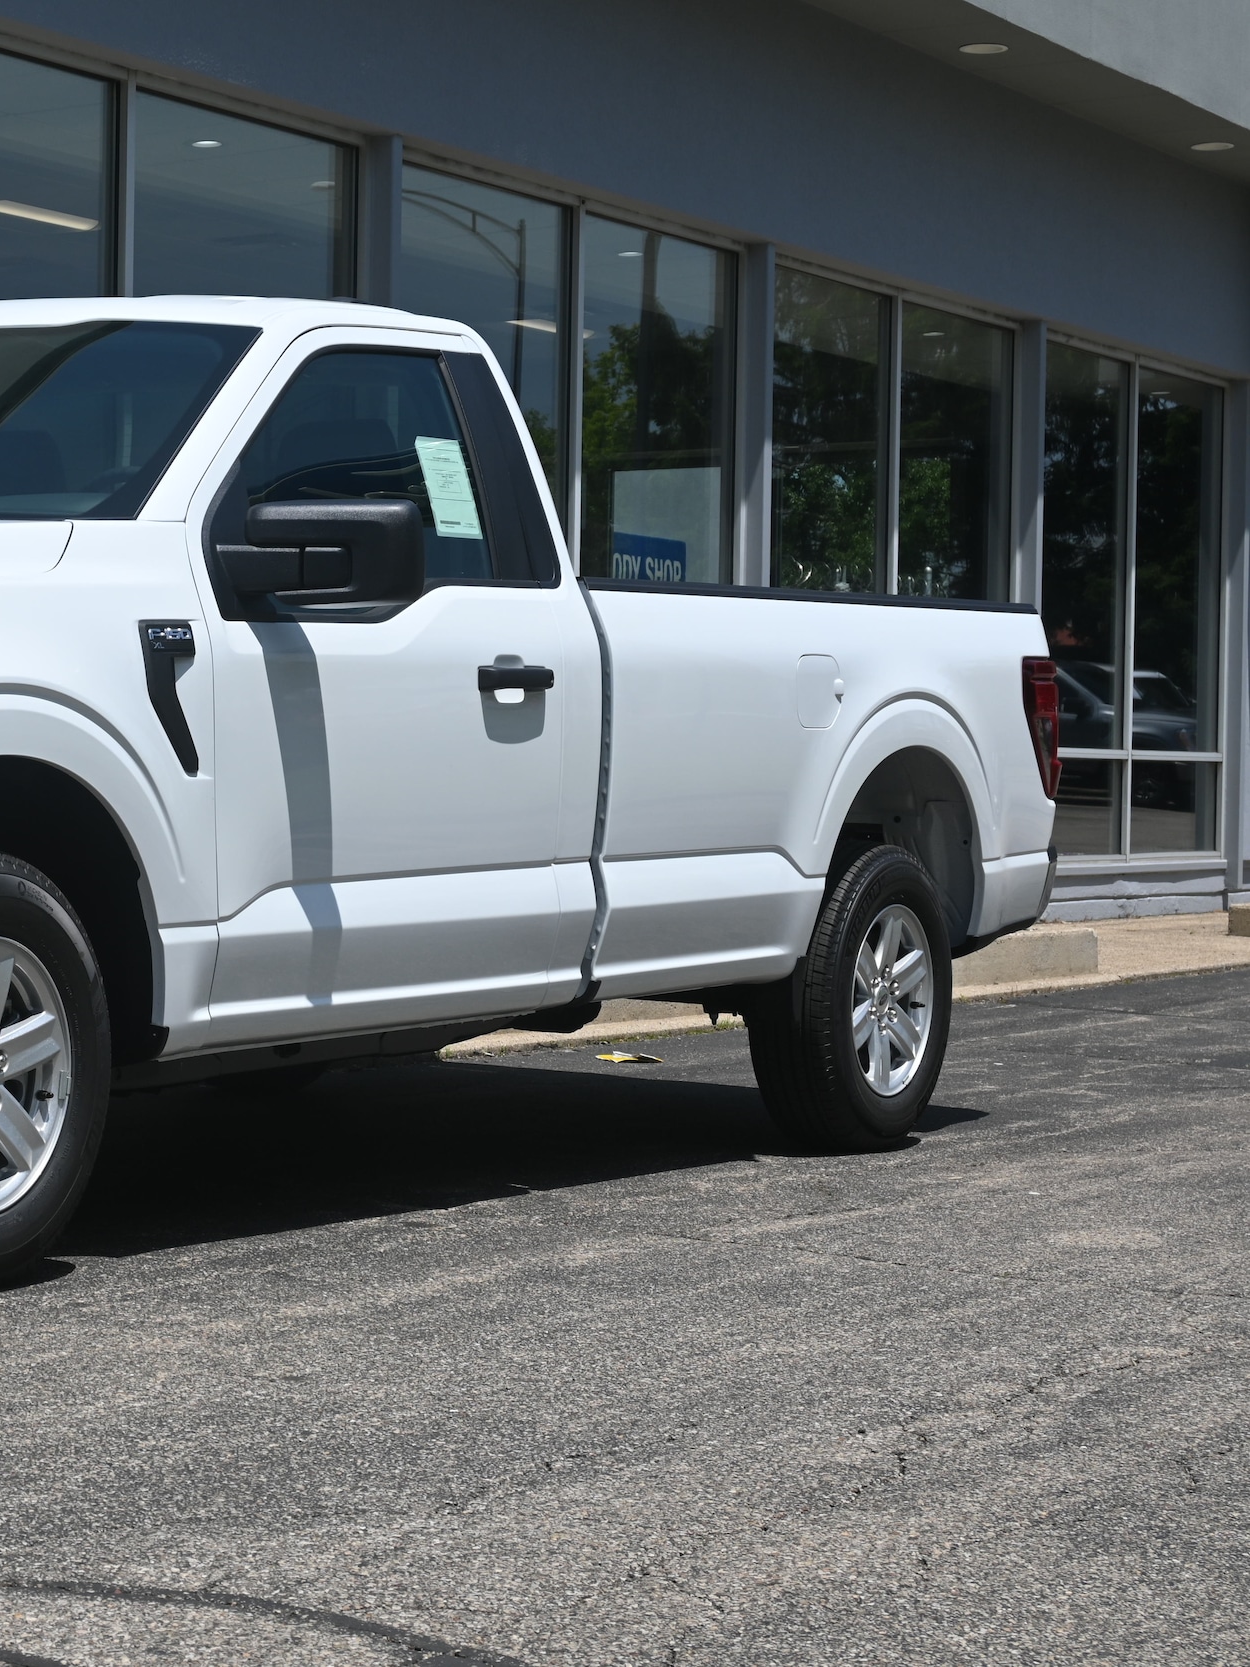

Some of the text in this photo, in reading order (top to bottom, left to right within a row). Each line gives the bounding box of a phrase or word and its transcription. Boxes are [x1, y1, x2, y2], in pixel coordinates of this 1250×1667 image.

[645, 556, 682, 582] SHOP
[147, 627, 192, 640] F-150
[150, 641, 165, 649] XL
